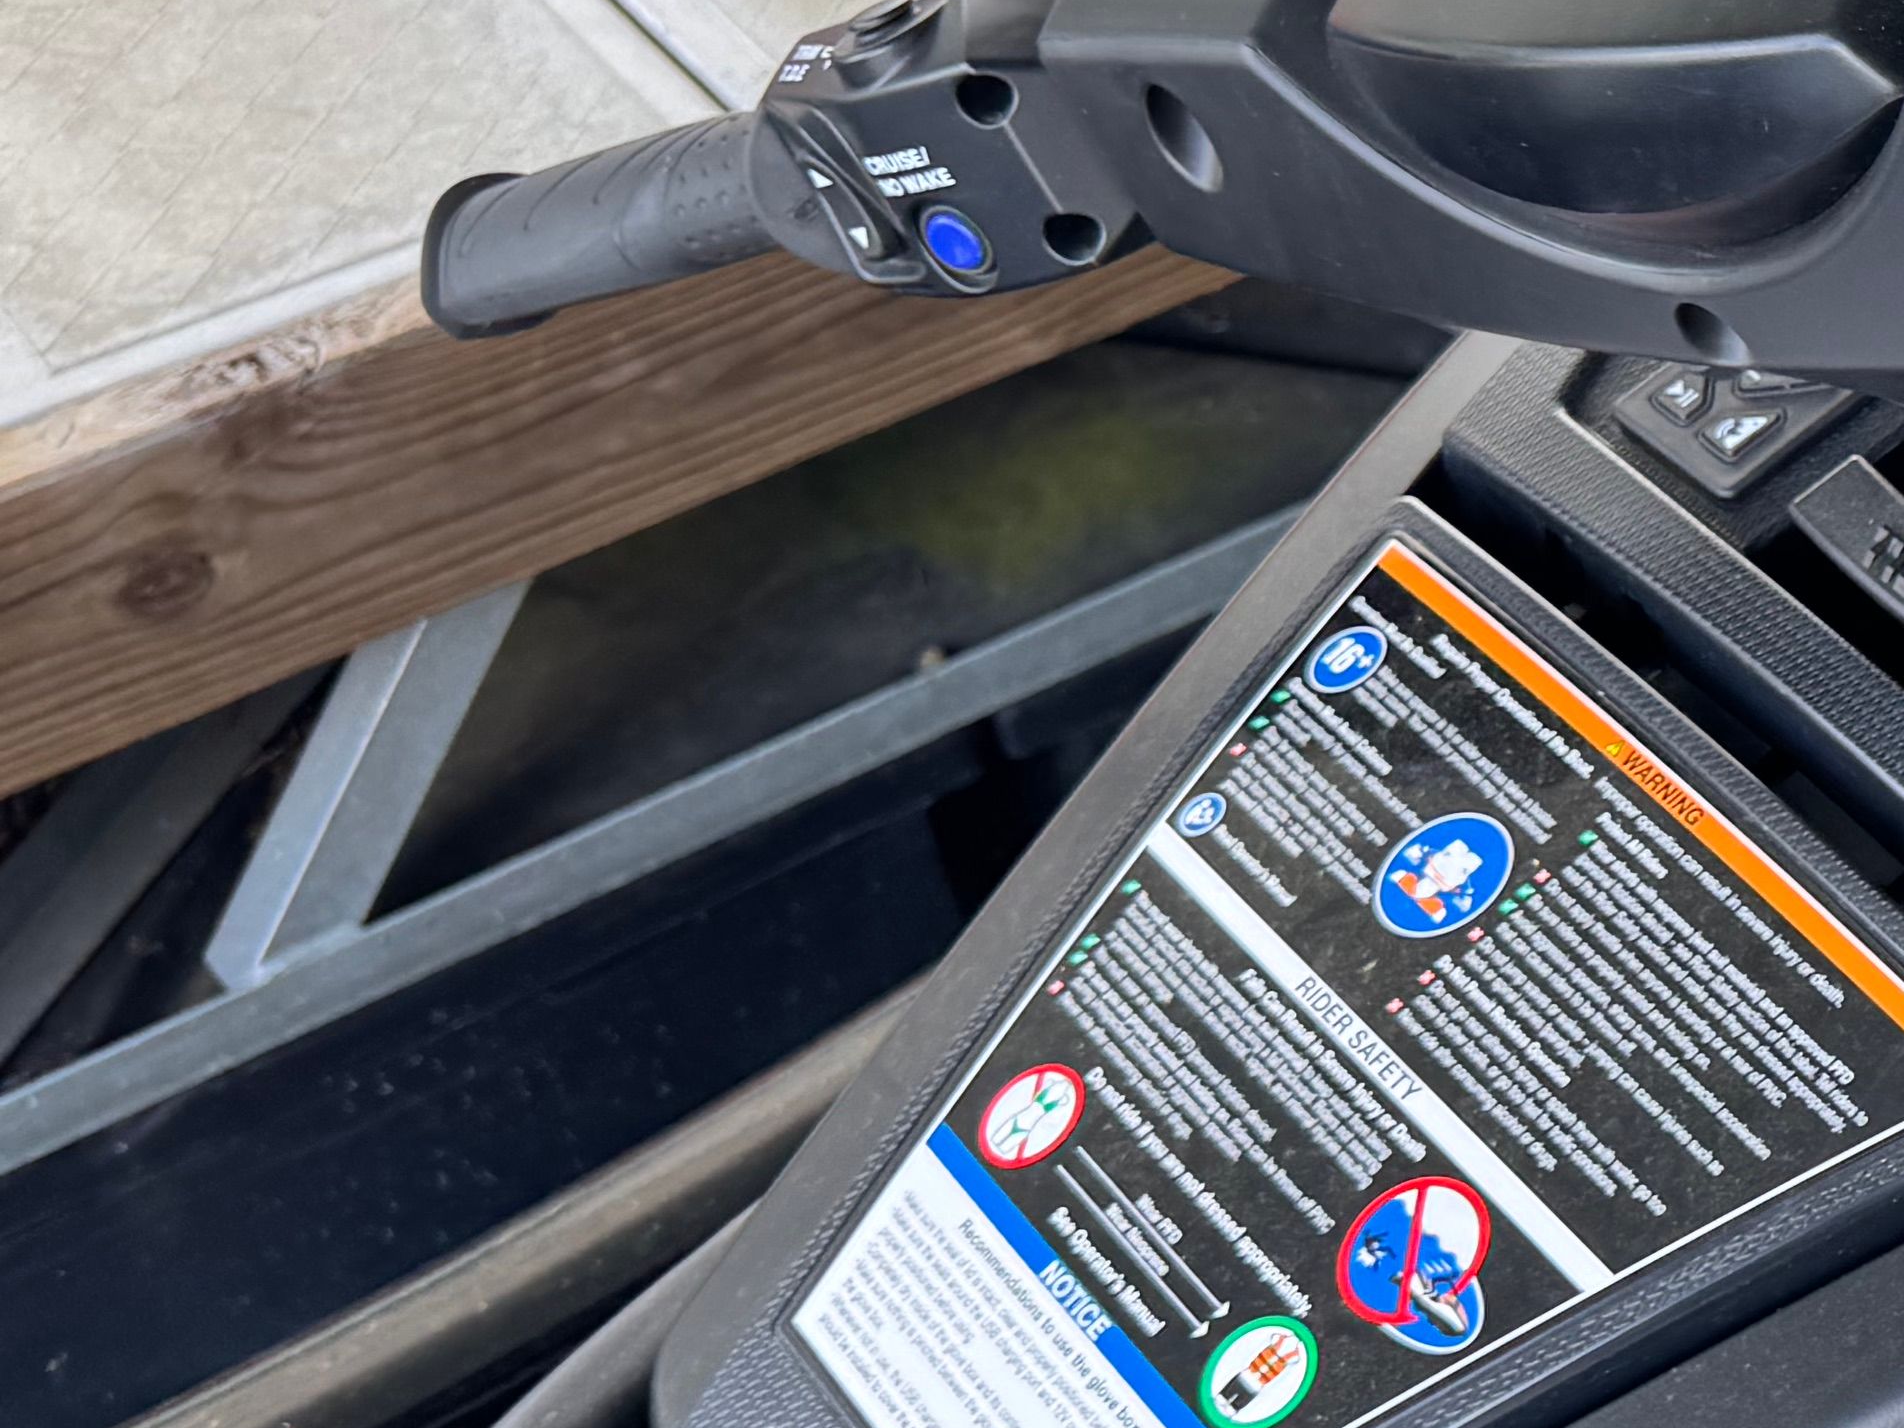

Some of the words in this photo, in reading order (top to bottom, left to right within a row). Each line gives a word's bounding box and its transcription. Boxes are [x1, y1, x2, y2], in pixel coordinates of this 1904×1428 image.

[863, 146, 930, 176] CRUISE/
[877, 177, 904, 197] NO
[902, 167, 956, 194] WAKE
[1322, 636, 1373, 675] 16+
[1619, 750, 1706, 827] WARNING
[1236, 966, 1270, 999] Falls
[1257, 988, 1289, 1019] Can
[1277, 1008, 1318, 1048] Result
[1293, 975, 1357, 1037] RIDER
[1343, 1026, 1421, 1103] SAFETY
[1305, 1037, 1328, 1059] in
[1083, 1065, 1110, 1091] Do
[1316, 1048, 1360, 1091] Severe
[1098, 1081, 1127, 1109] not
[1345, 1080, 1388, 1122] Injury
[1114, 1099, 1146, 1131] ride
[1133, 1120, 1154, 1139] if
[1375, 1111, 1397, 1132] or
[1138, 1131, 1169, 1162] you
[1387, 1121, 1430, 1163] Death
[1159, 1152, 1186, 1178] are
[1176, 1168, 1207, 1198] not
[1045, 1206, 1079, 1240] See
[1194, 1187, 1247, 1242] dressed
[1061, 1227, 1129, 1299] Operator's
[1231, 1231, 1316, 1320] appropriately.
[957, 1218, 1049, 1323] Recommendations
[1039, 1315, 1060, 1336] to
[1050, 1330, 1076, 1358] use
[1069, 1350, 1096, 1379] the
[1084, 1371, 1124, 1414] glove
[1037, 1258, 1113, 1341] NOTICE
[1114, 1283, 1165, 1337] Manual
